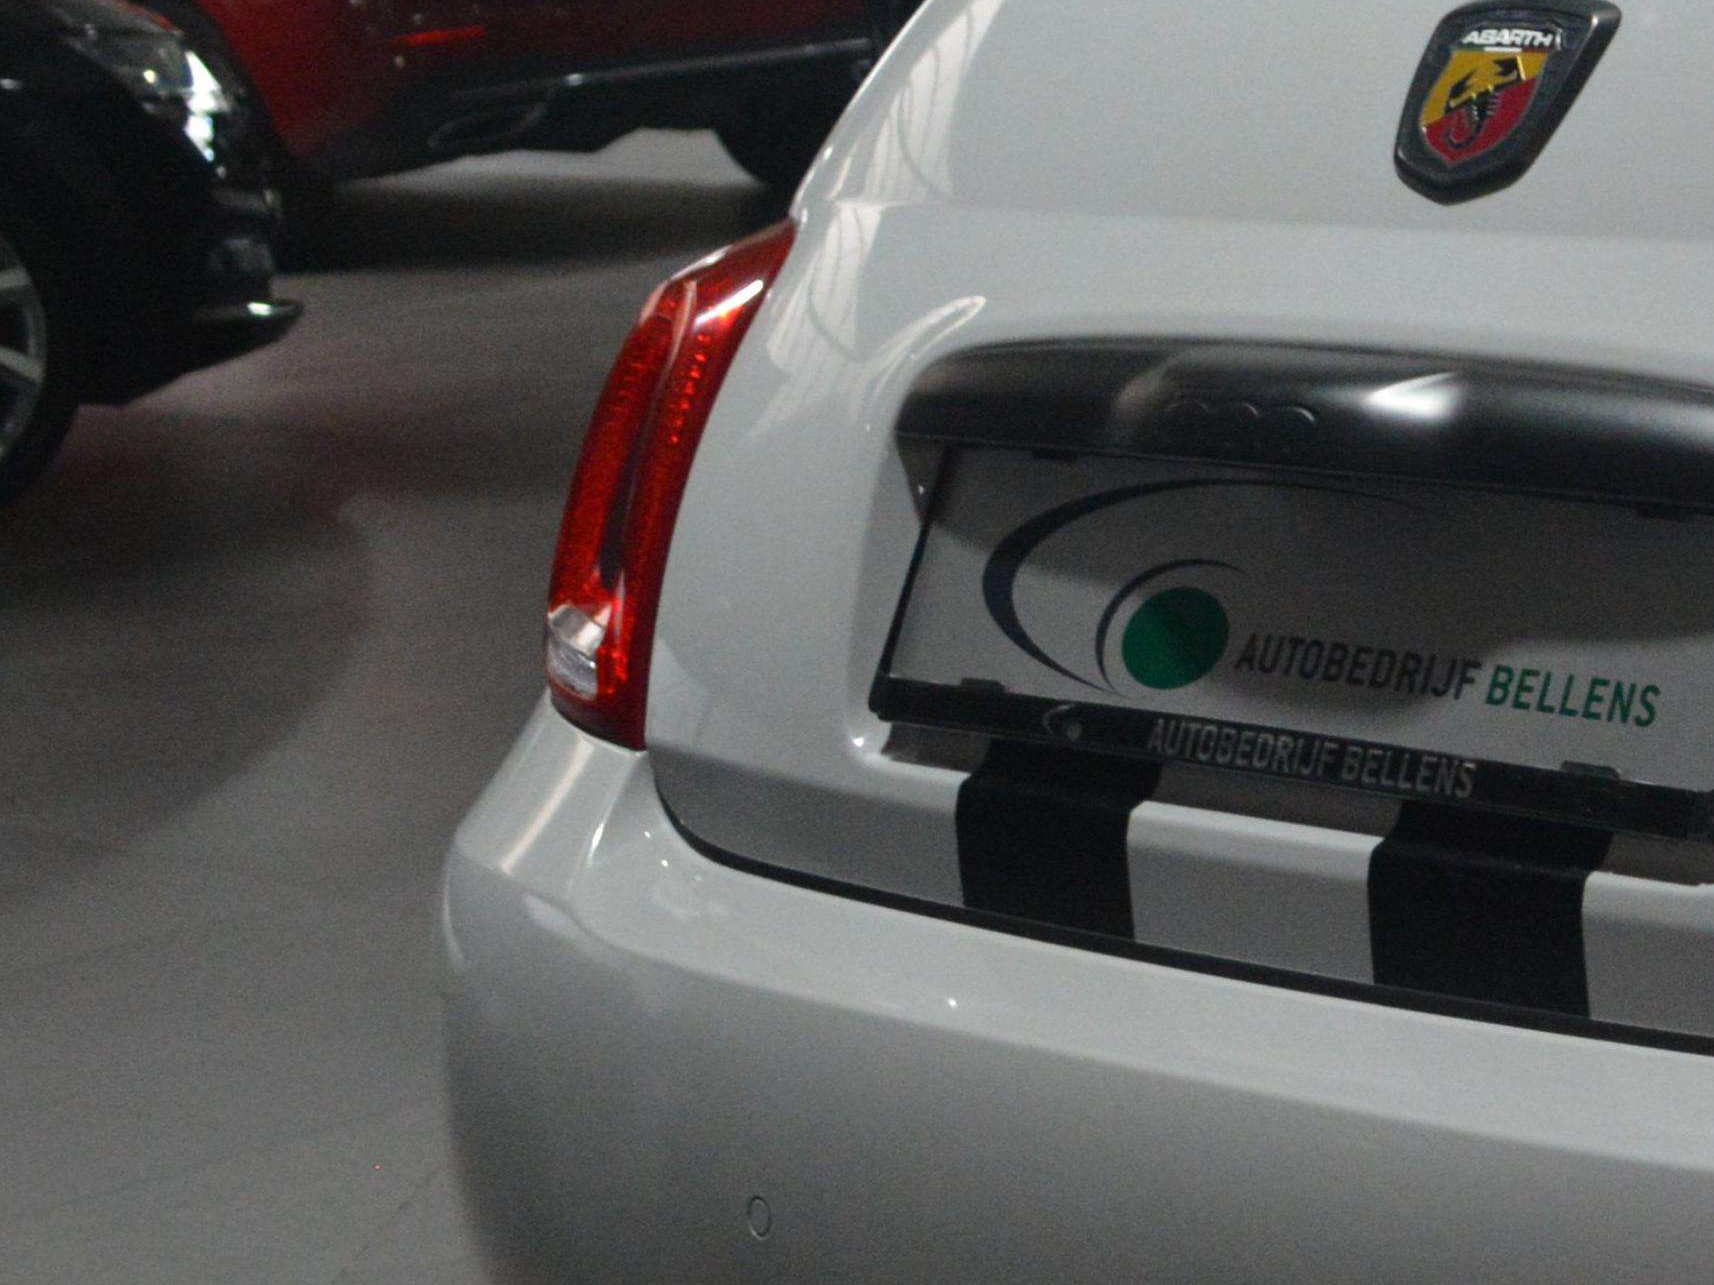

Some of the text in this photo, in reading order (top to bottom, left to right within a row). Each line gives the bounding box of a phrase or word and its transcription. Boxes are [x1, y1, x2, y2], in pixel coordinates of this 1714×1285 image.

[1462, 29, 1554, 46] ABARTH
[1234, 633, 1661, 728] AUTOBEDRIJF BELLENS
[1146, 715, 1478, 801] AUTOBEDRIJF BELLENS
